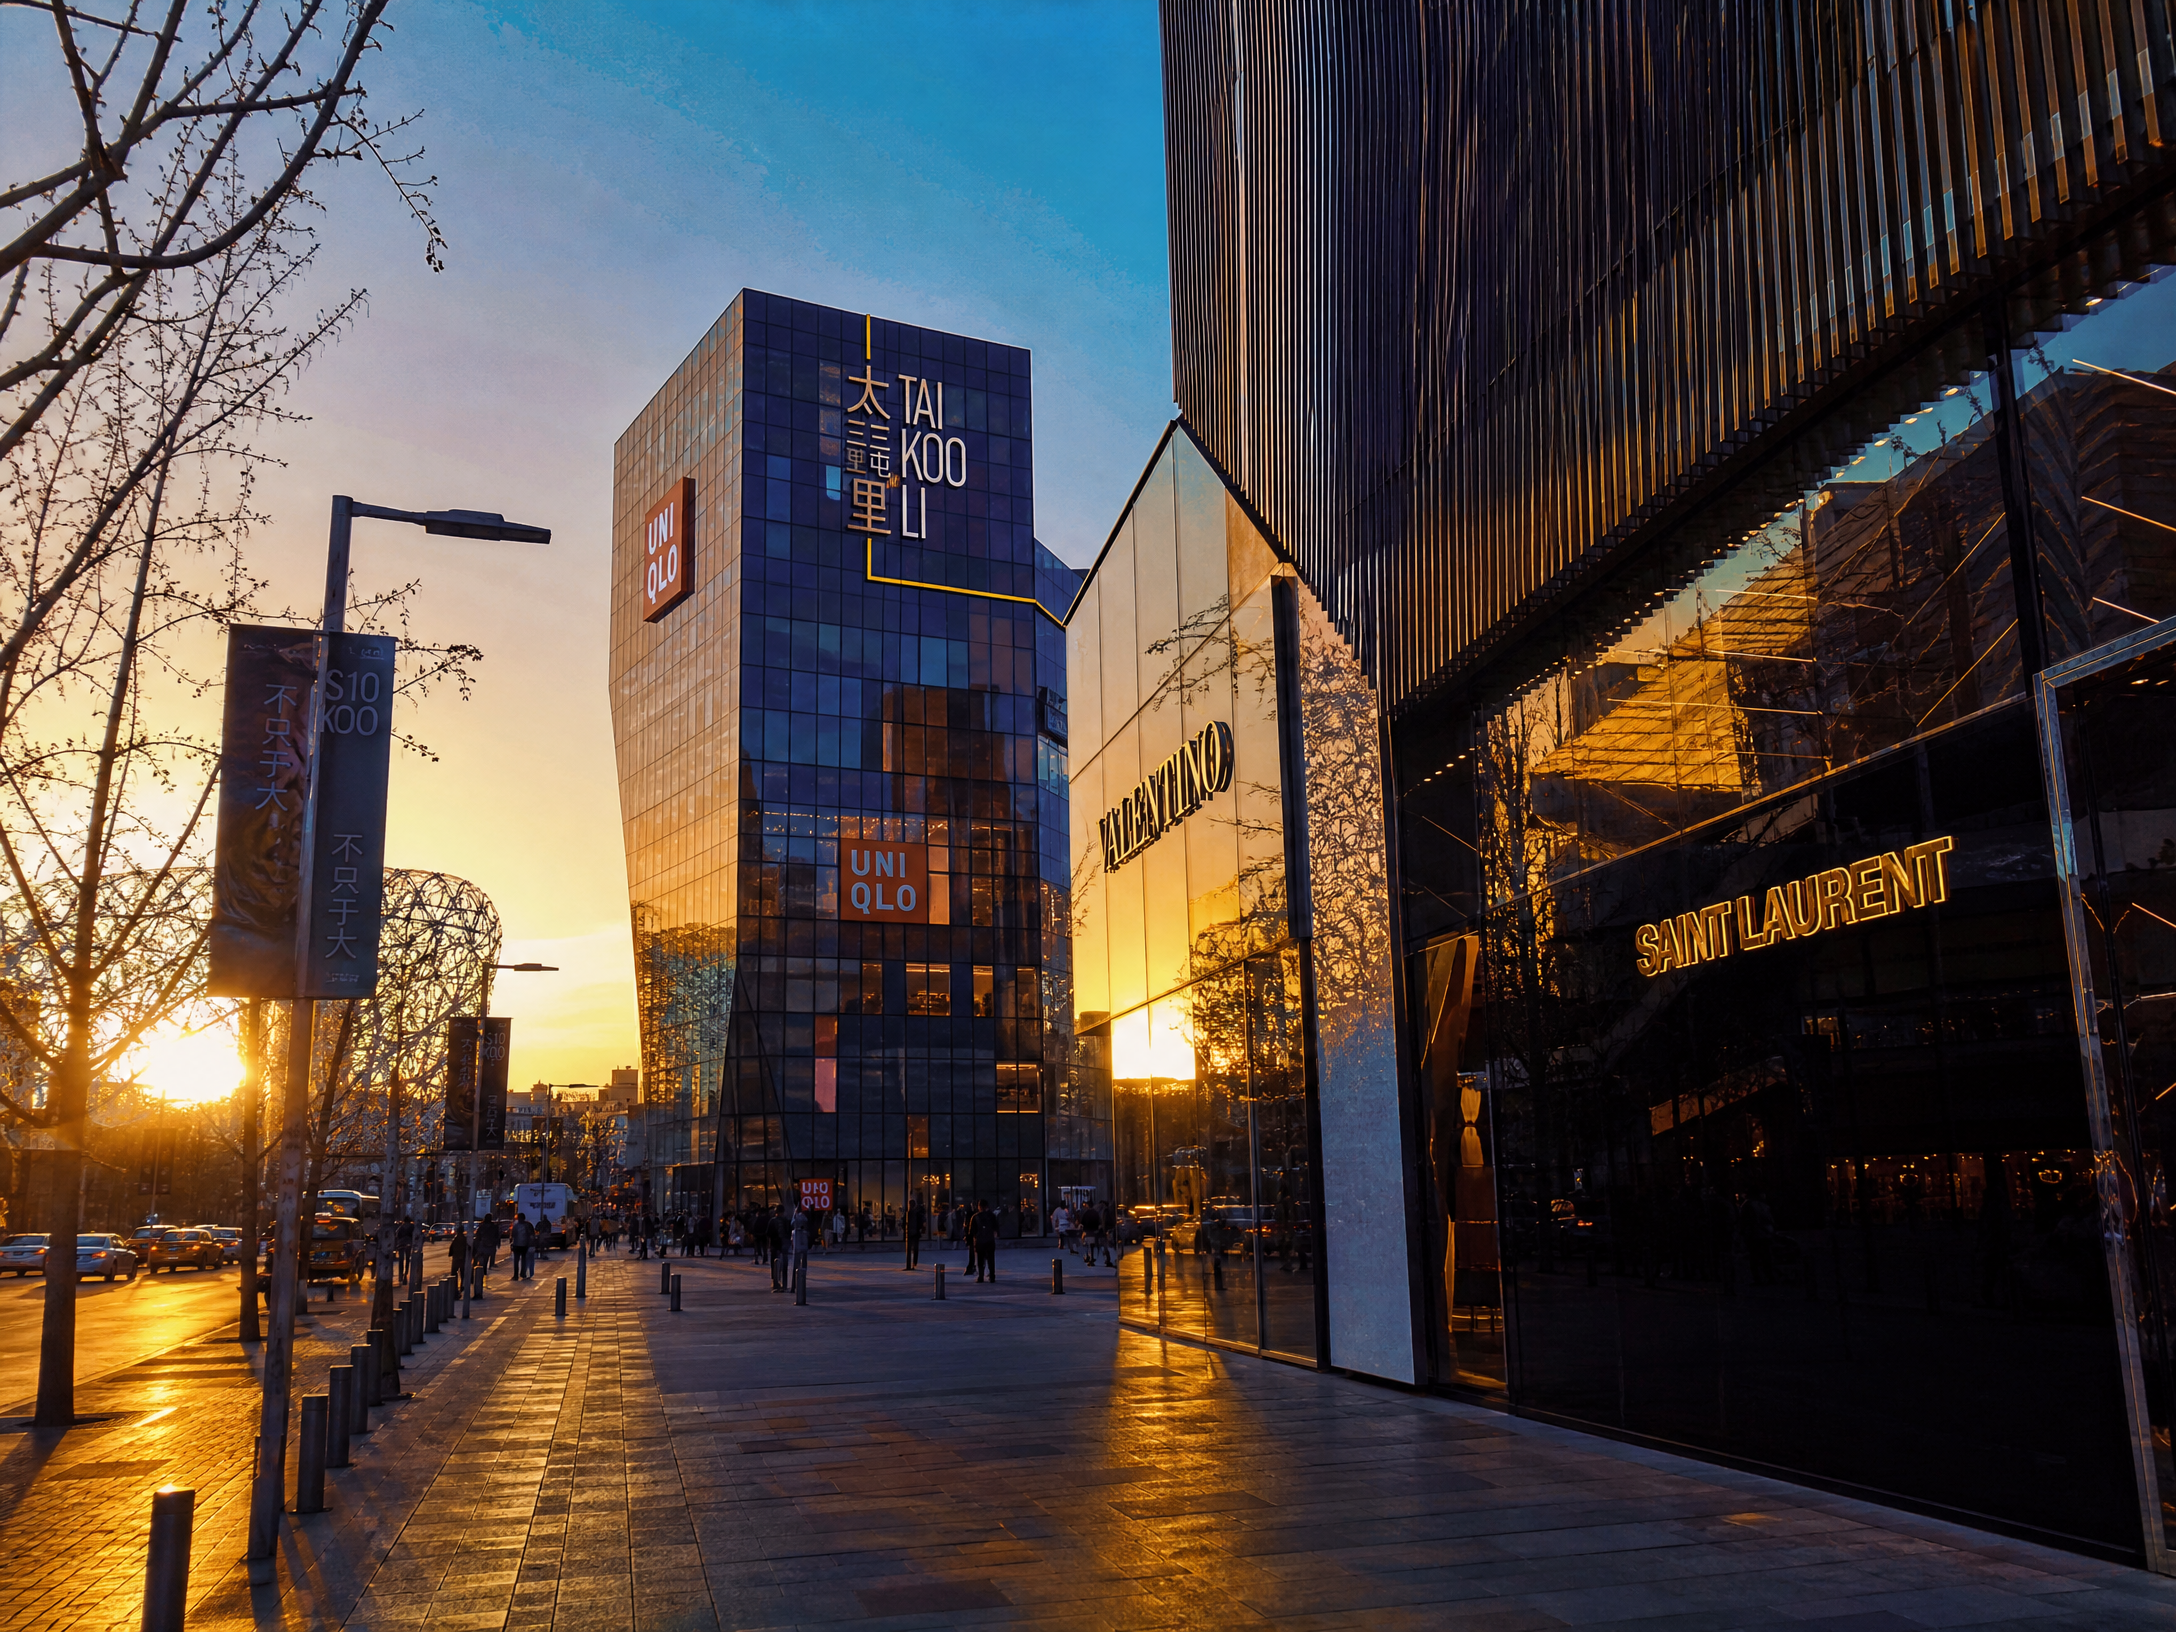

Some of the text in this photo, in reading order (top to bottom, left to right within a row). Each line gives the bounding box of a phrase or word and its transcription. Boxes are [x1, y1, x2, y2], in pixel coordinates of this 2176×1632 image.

[898, 374, 943, 430] TAI
[901, 428, 967, 488] KOO
[648, 502, 674, 555] UNI
[902, 484, 926, 539] LI
[647, 544, 678, 605] QLO
[1096, 720, 1234, 873] VALENTINO
[851, 849, 906, 878] UNI
[324, 833, 363, 960] 不只于大
[851, 881, 917, 915] QLO
[1635, 835, 1959, 977] SAINT LAURENT
